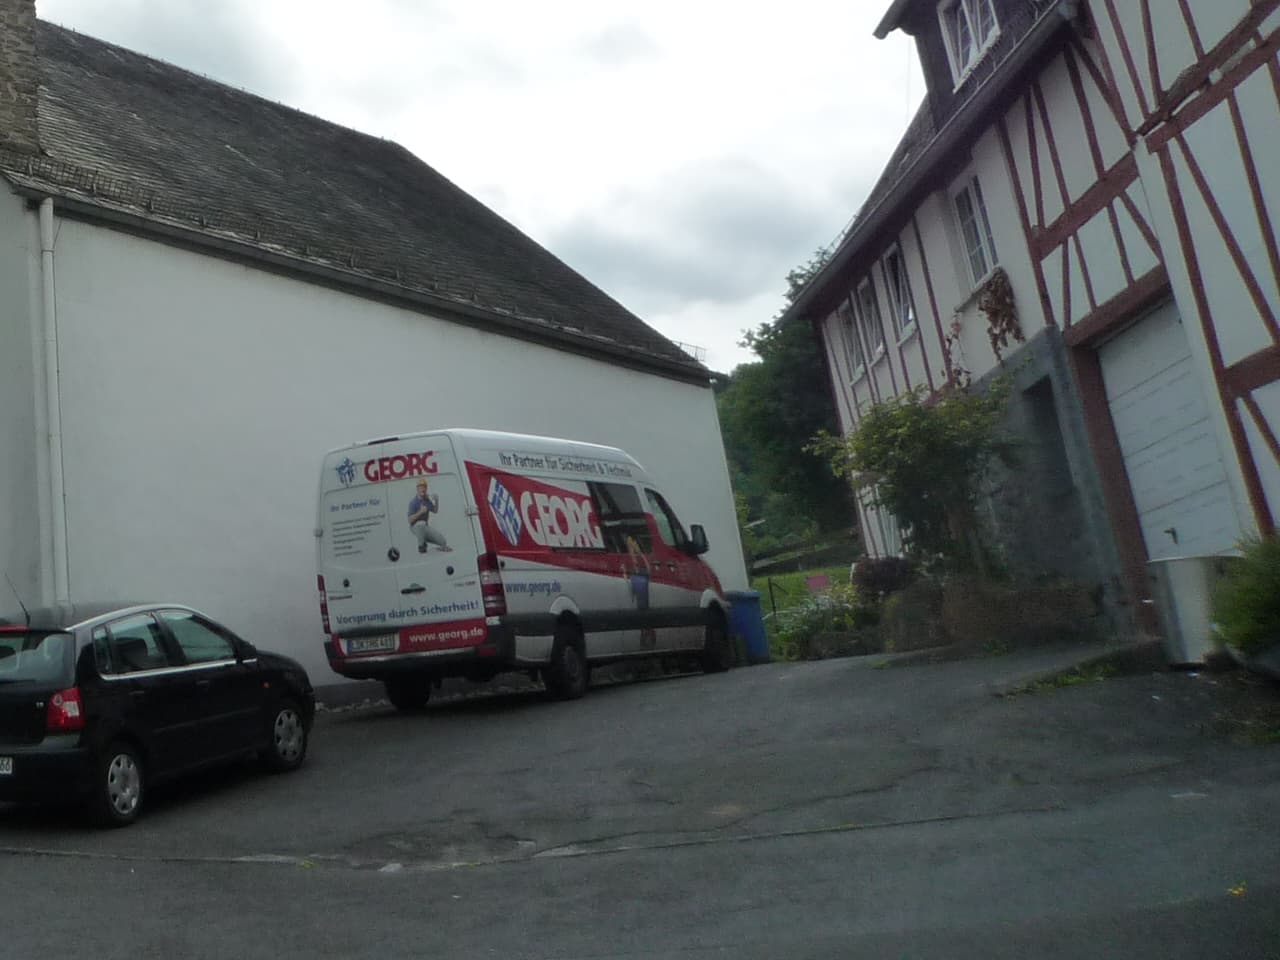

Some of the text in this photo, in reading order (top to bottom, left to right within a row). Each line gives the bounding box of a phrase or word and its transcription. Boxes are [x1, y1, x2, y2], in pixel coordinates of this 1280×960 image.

[364, 451, 437, 482] GEORG
[500, 452, 511, 465] Ihr
[513, 453, 543, 468] Partner
[520, 491, 605, 548] GEORG
[506, 579, 561, 596] www.georg.de
[336, 600, 480, 625] Vorsprung durch Sicherheit!
[409, 626, 484, 642] www.georg.de
